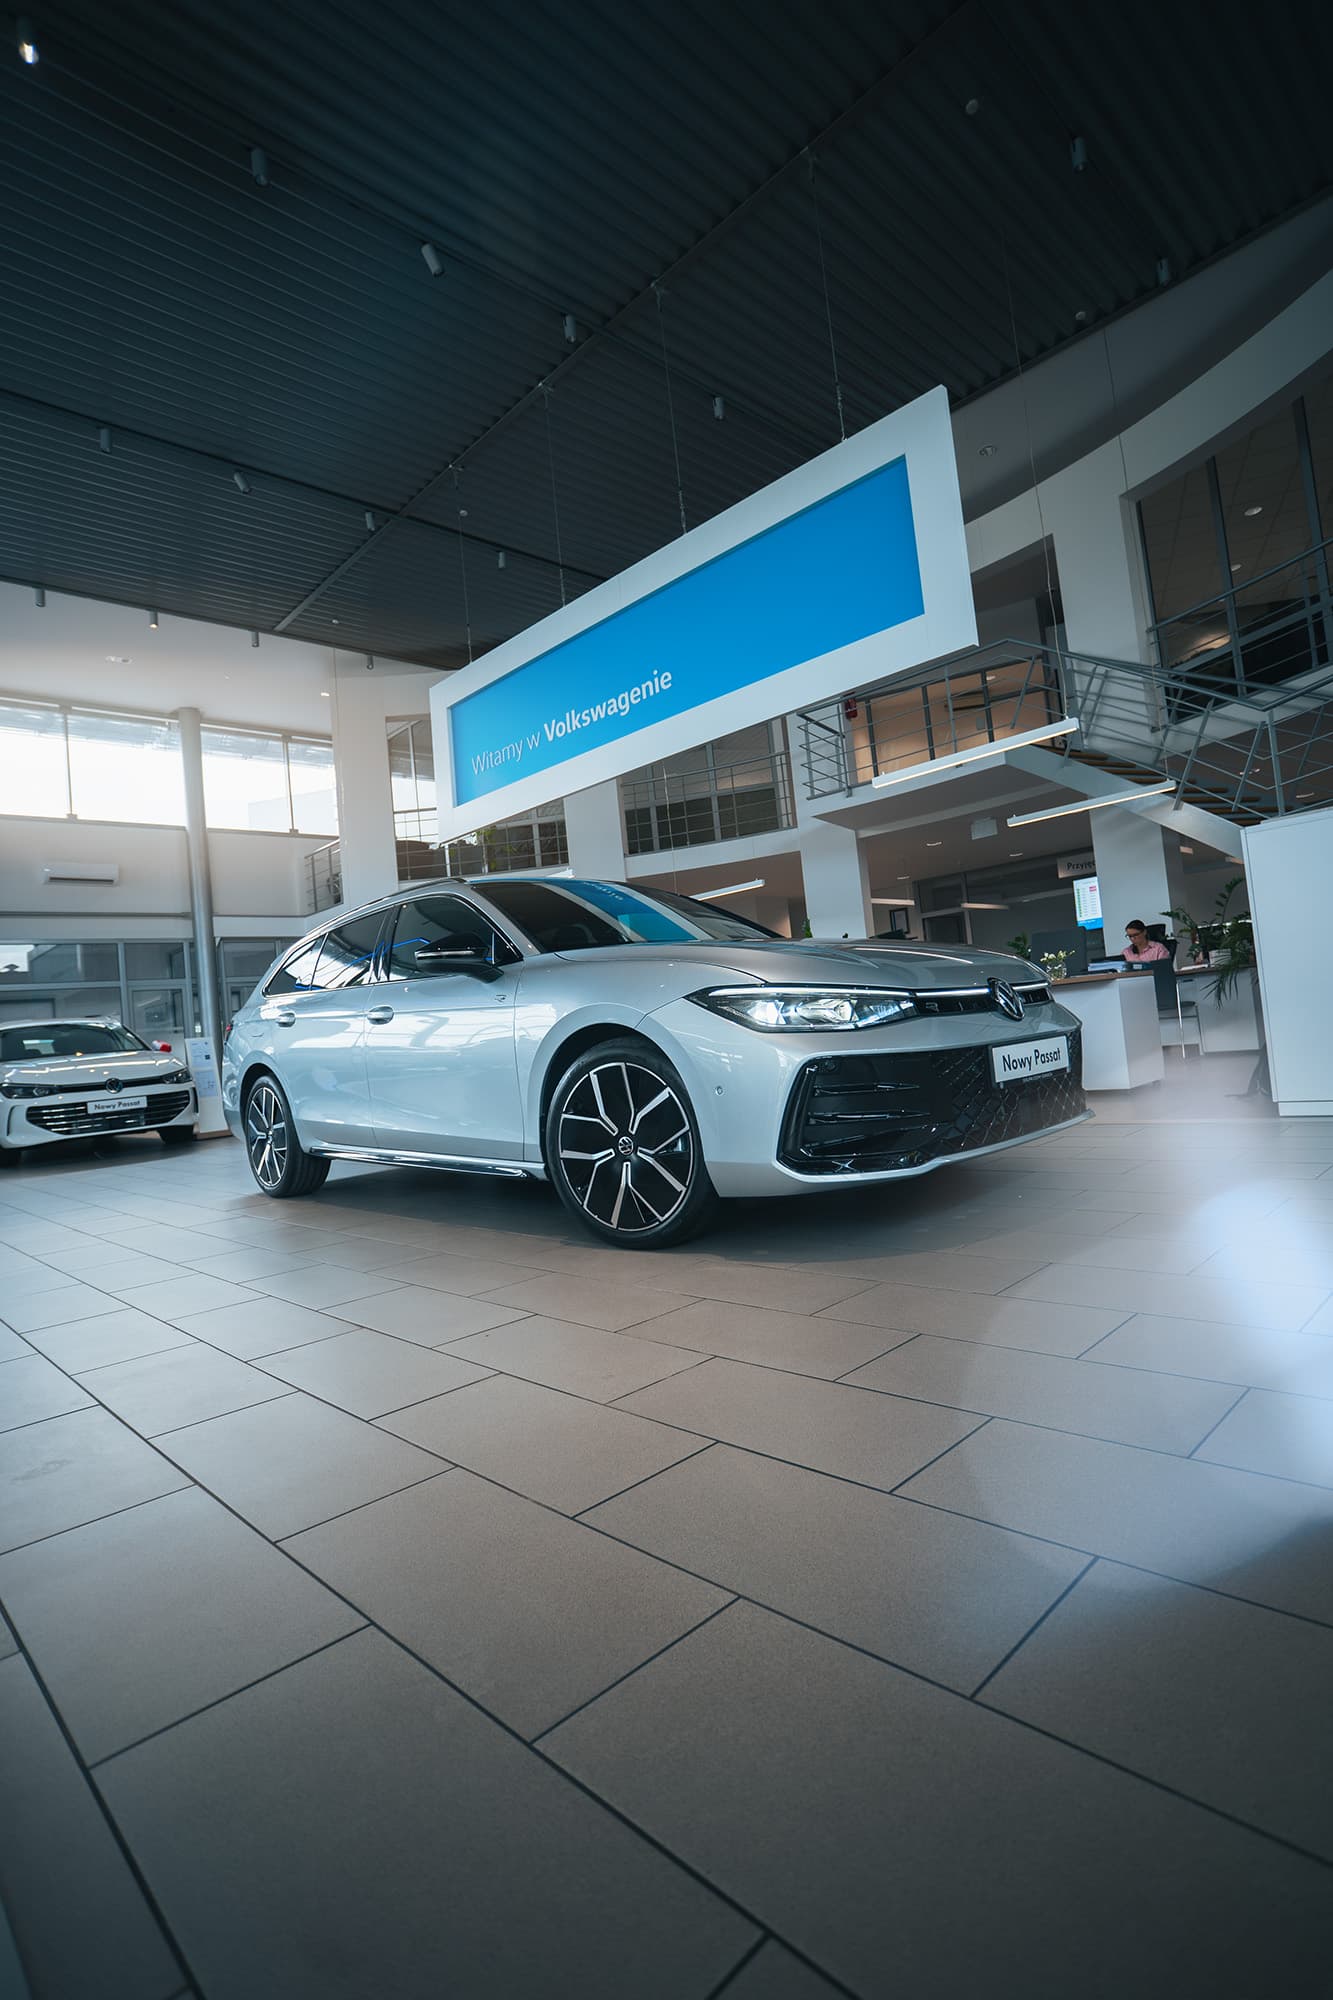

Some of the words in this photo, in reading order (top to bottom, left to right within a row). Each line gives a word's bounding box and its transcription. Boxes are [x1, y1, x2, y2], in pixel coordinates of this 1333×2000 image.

[471, 739, 524, 775] Witamy
[526, 731, 542, 750] w
[543, 669, 672, 742] Volkswagenie
[1002, 1054, 1032, 1072] Nowy
[1034, 1047, 1061, 1065] Passat
